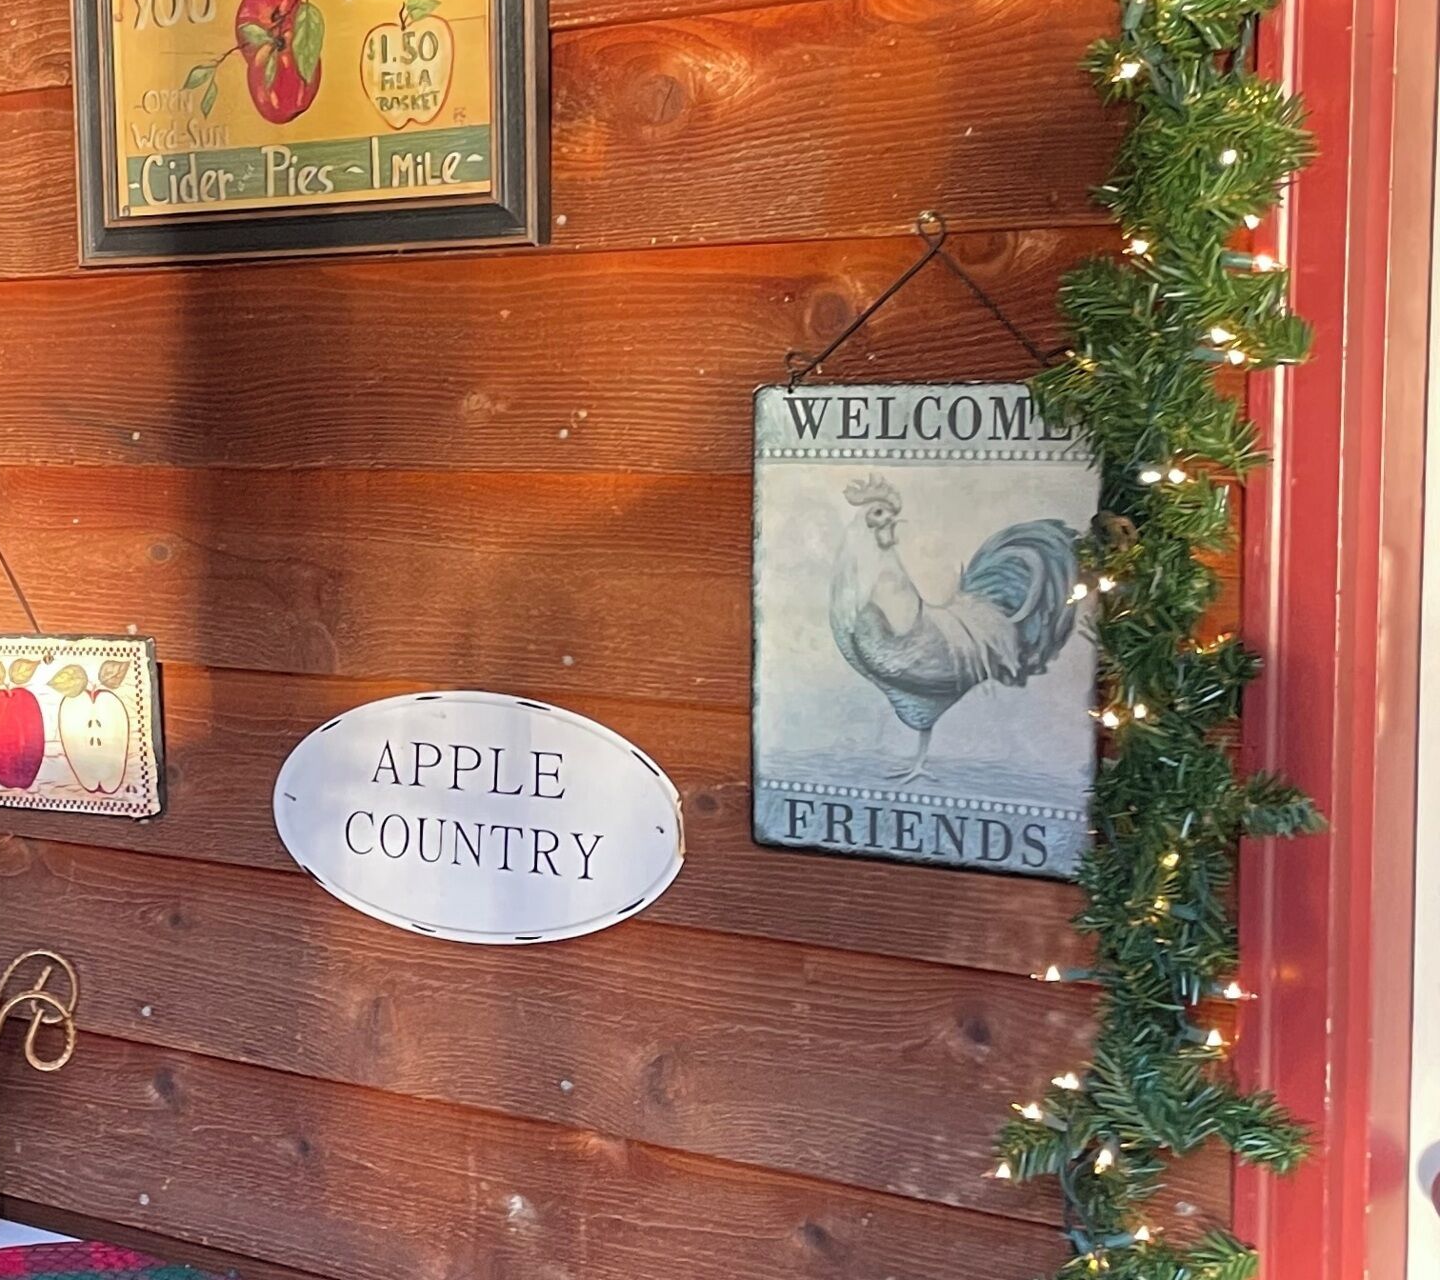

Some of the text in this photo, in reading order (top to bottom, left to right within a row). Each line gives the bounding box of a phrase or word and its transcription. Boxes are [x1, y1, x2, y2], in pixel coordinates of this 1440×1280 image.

[367, 30, 439, 65] $1.50
[375, 90, 440, 112] BASKET
[380, 69, 432, 92] FILL A
[261, 145, 335, 197] Pies
[371, 739, 566, 800] APPLE
[344, 810, 605, 880] COUNTRY
[783, 798, 1050, 868] FRIENDS
